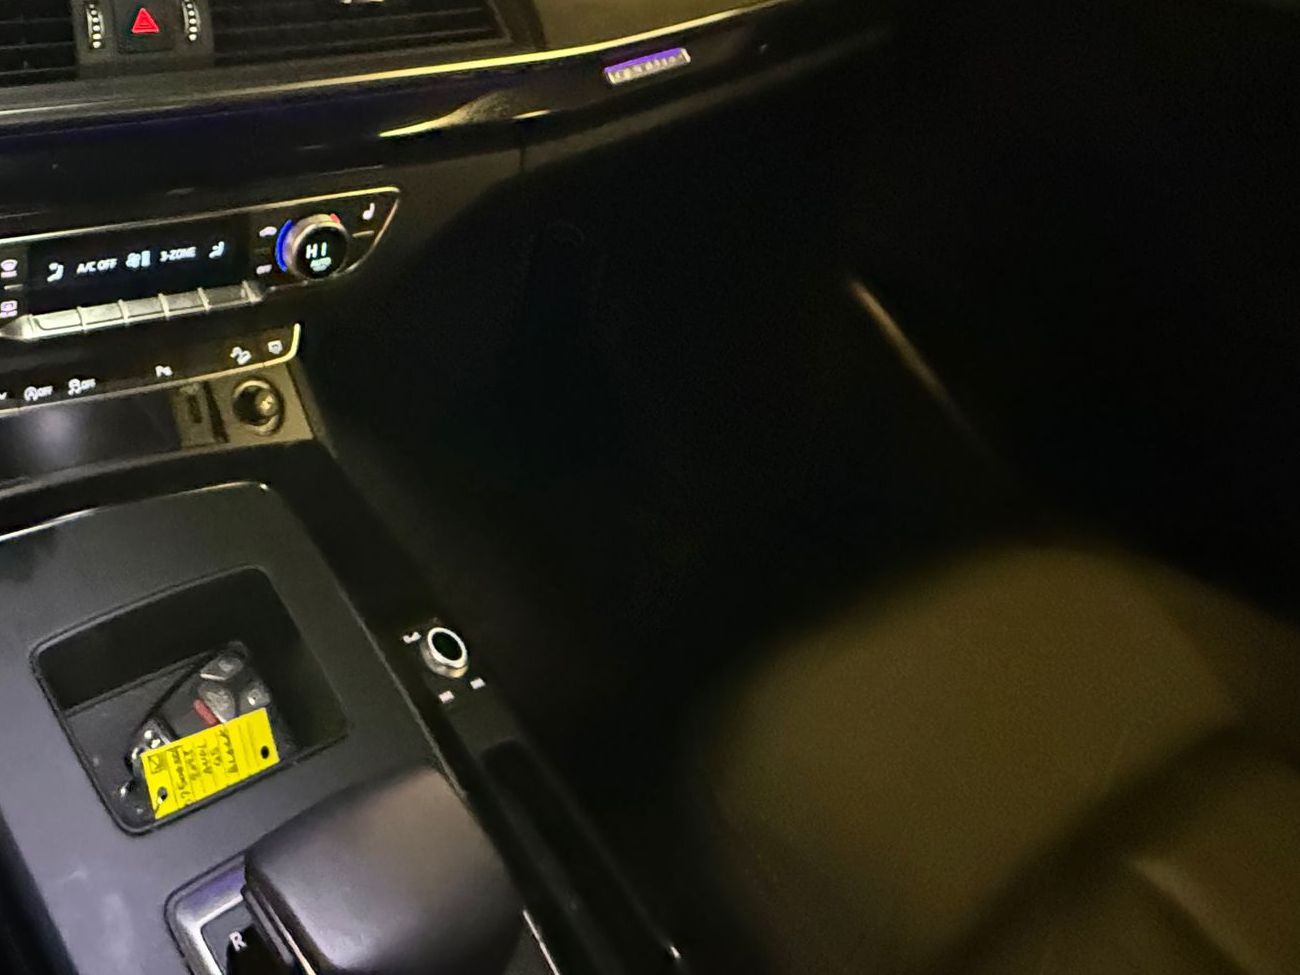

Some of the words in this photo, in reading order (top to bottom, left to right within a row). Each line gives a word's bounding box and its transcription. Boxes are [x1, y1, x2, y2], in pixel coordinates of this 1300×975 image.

[160, 246, 197, 262] 3-ZONE
[306, 242, 327, 259] HI
[76, 261, 97, 274] A/C
[97, 258, 118, 272] OFF
[229, 931, 247, 951] R
